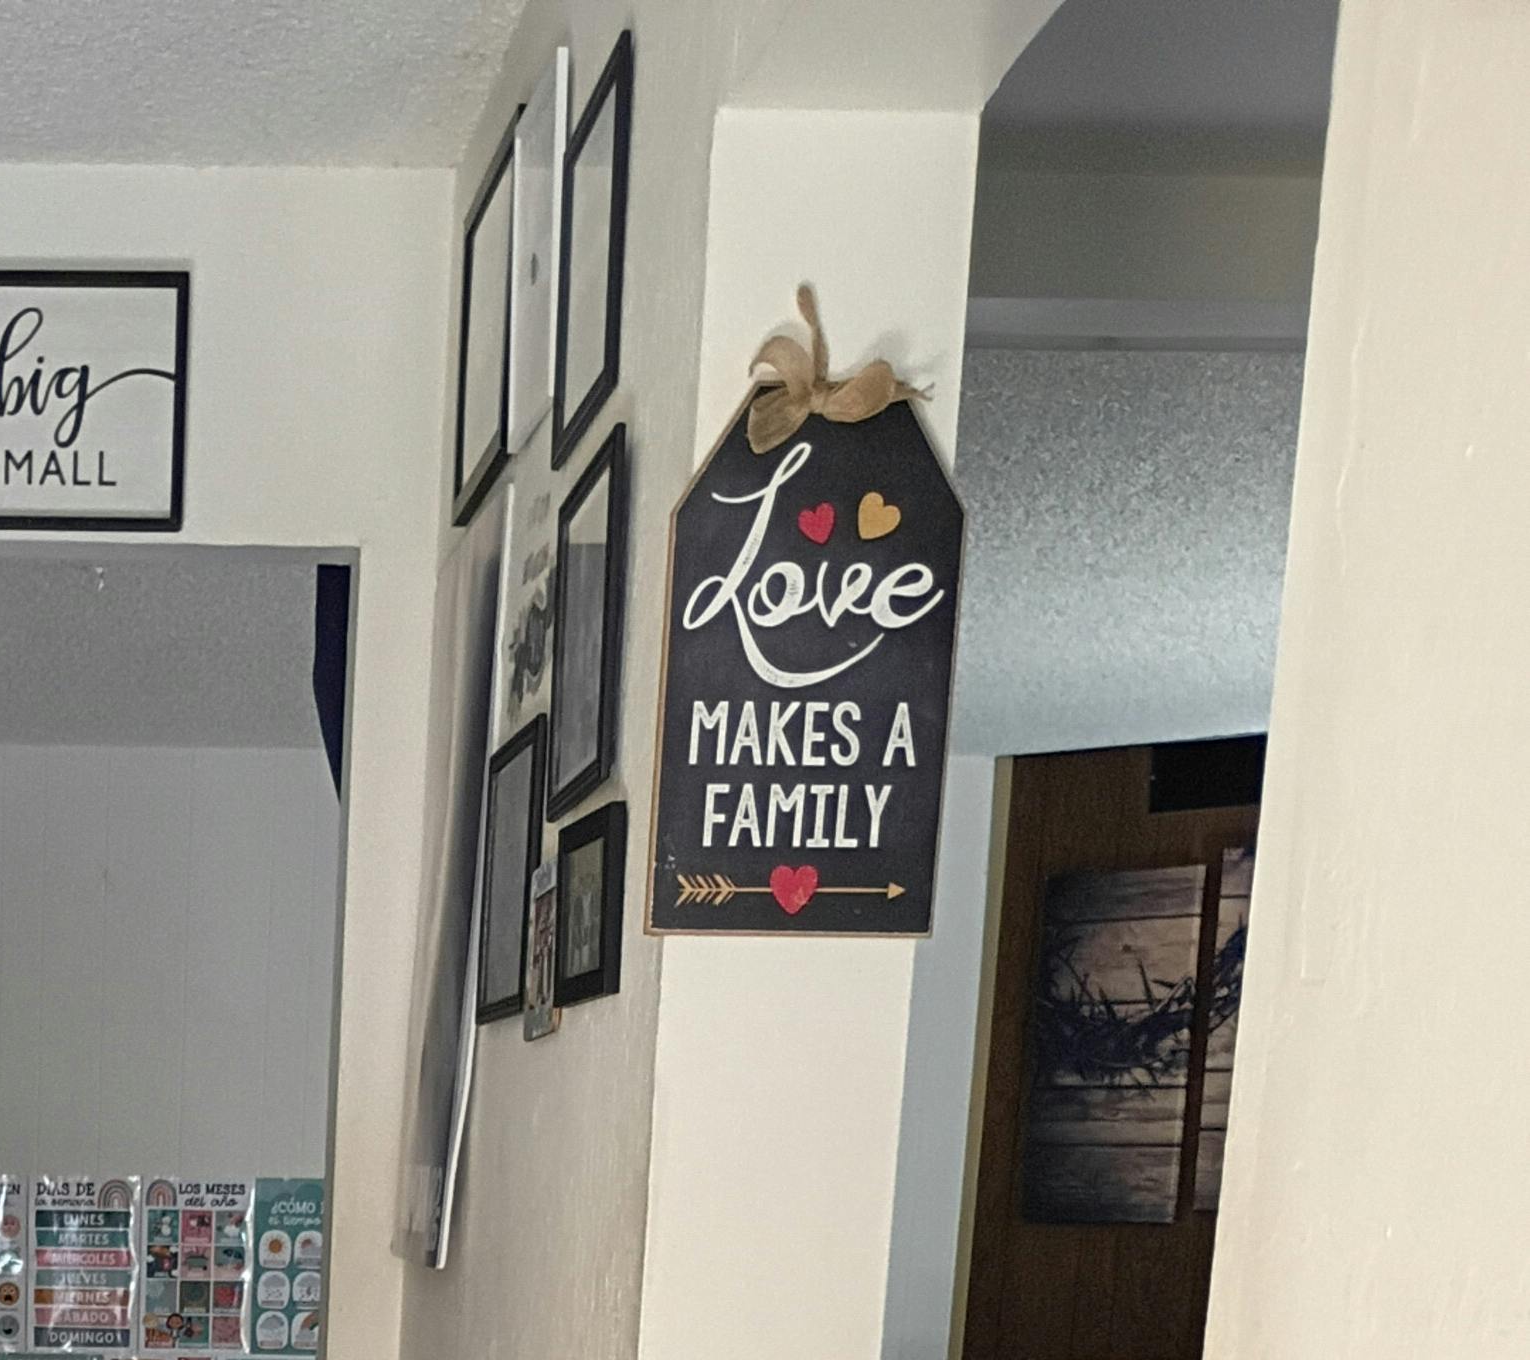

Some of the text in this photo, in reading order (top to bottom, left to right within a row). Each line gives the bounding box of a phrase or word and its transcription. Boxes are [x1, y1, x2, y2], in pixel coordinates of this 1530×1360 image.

[682, 442, 945, 689] Love
[688, 700, 917, 767] MAKES A
[701, 783, 893, 849] FAMILY
[76, 1182, 95, 1196] DE
[178, 1183, 245, 1195] LOS MESES
[58, 1233, 109, 1245] MARTES
[61, 1272, 107, 1284] JUEVES
[49, 1331, 114, 1344] DOMINGO
